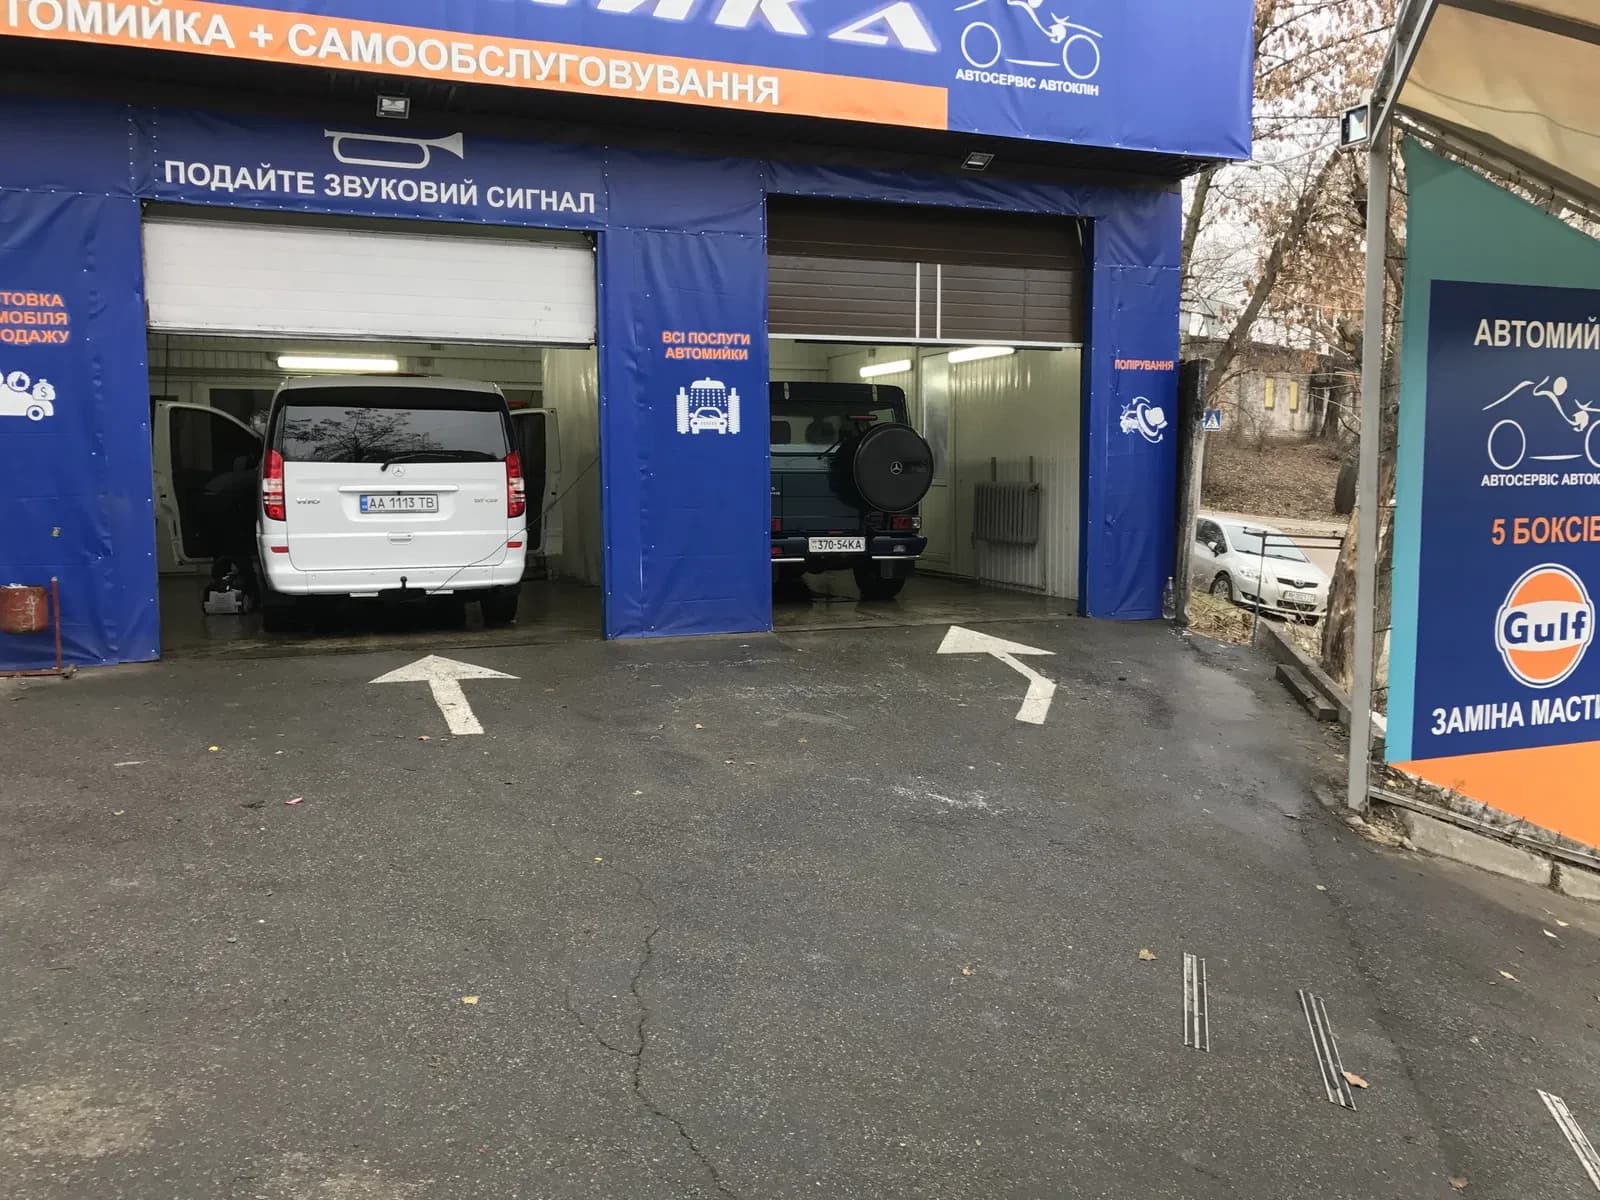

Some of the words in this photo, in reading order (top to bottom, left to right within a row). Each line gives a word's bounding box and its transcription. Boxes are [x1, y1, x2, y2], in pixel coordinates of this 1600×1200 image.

[288, 23, 779, 105] САМООБСЛУГОВУВАННЯ
[955, 69, 1036, 89] АВТОСЕРВІС
[1038, 78, 1099, 96] АВТОКЛІН
[165, 160, 315, 194] ПОДАЙТЕ
[324, 173, 478, 206] ЗВУКОВИЙ
[486, 187, 596, 214] СИГНАЛ
[0, 329, 70, 345] ОДАЖУ
[662, 331, 685, 343] ВСІ
[688, 332, 751, 345] ПОСЛУГИ
[1473, 315, 1600, 350] АВТОМИЙ
[665, 345, 749, 360] АВТОМИЙКИ
[1481, 473, 1559, 487] АВТОСЕРВІС
[389, 497, 415, 508] 1113
[1491, 518, 1506, 545] 5
[1503, 610, 1587, 645] Gulf
[1431, 701, 1525, 736] ЗАМІНА
[1531, 694, 1600, 726] МАСТ
